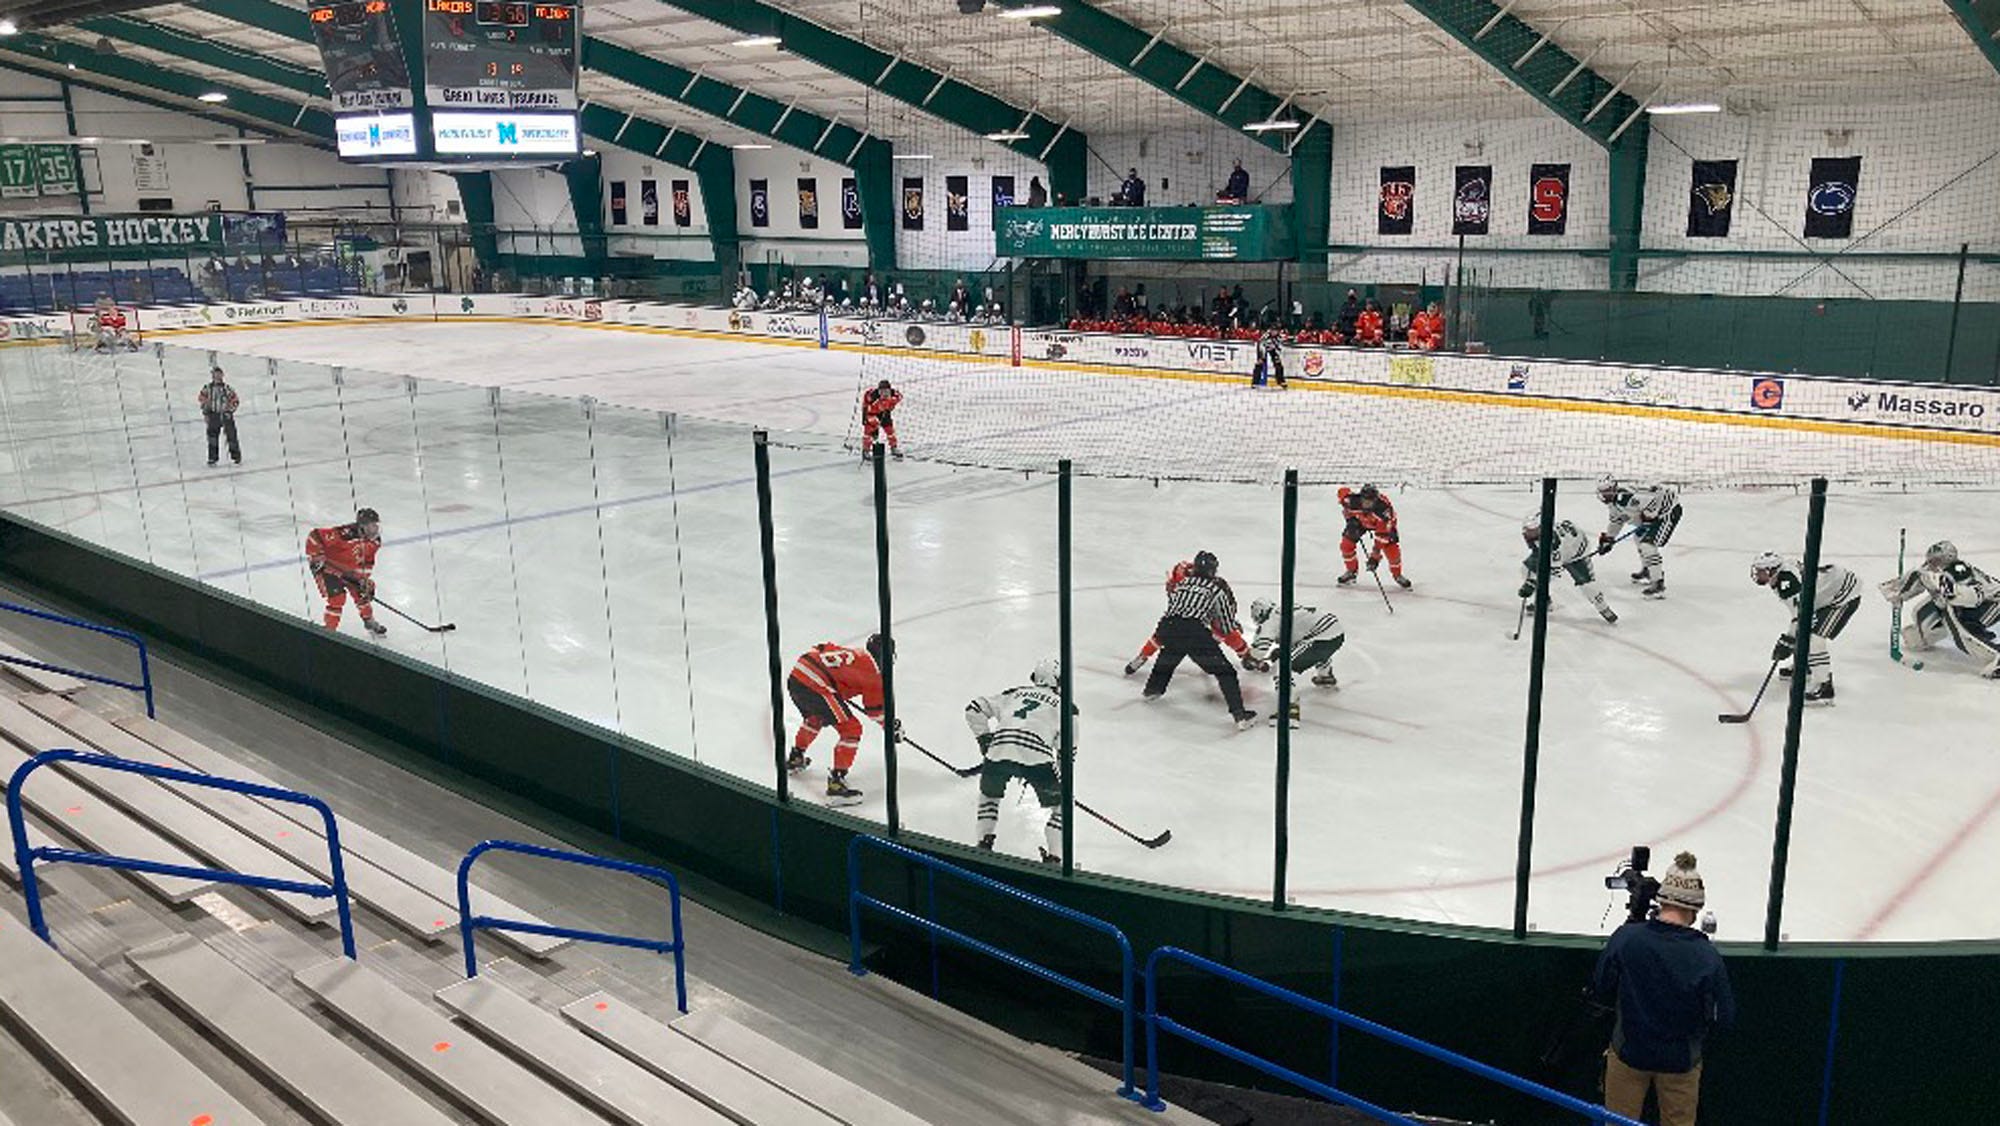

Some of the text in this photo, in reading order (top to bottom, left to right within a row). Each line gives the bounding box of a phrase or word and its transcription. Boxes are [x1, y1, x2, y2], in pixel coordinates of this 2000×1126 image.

[4, 160, 25, 184] 17
[40, 156, 70, 181] 35
[0, 219, 98, 249] AKERS
[105, 216, 210, 247] HOCKEY
[1149, 225, 1197, 240] CENTER
[1878, 392, 1985, 418] Massaro
[1013, 698, 1041, 719] 7
